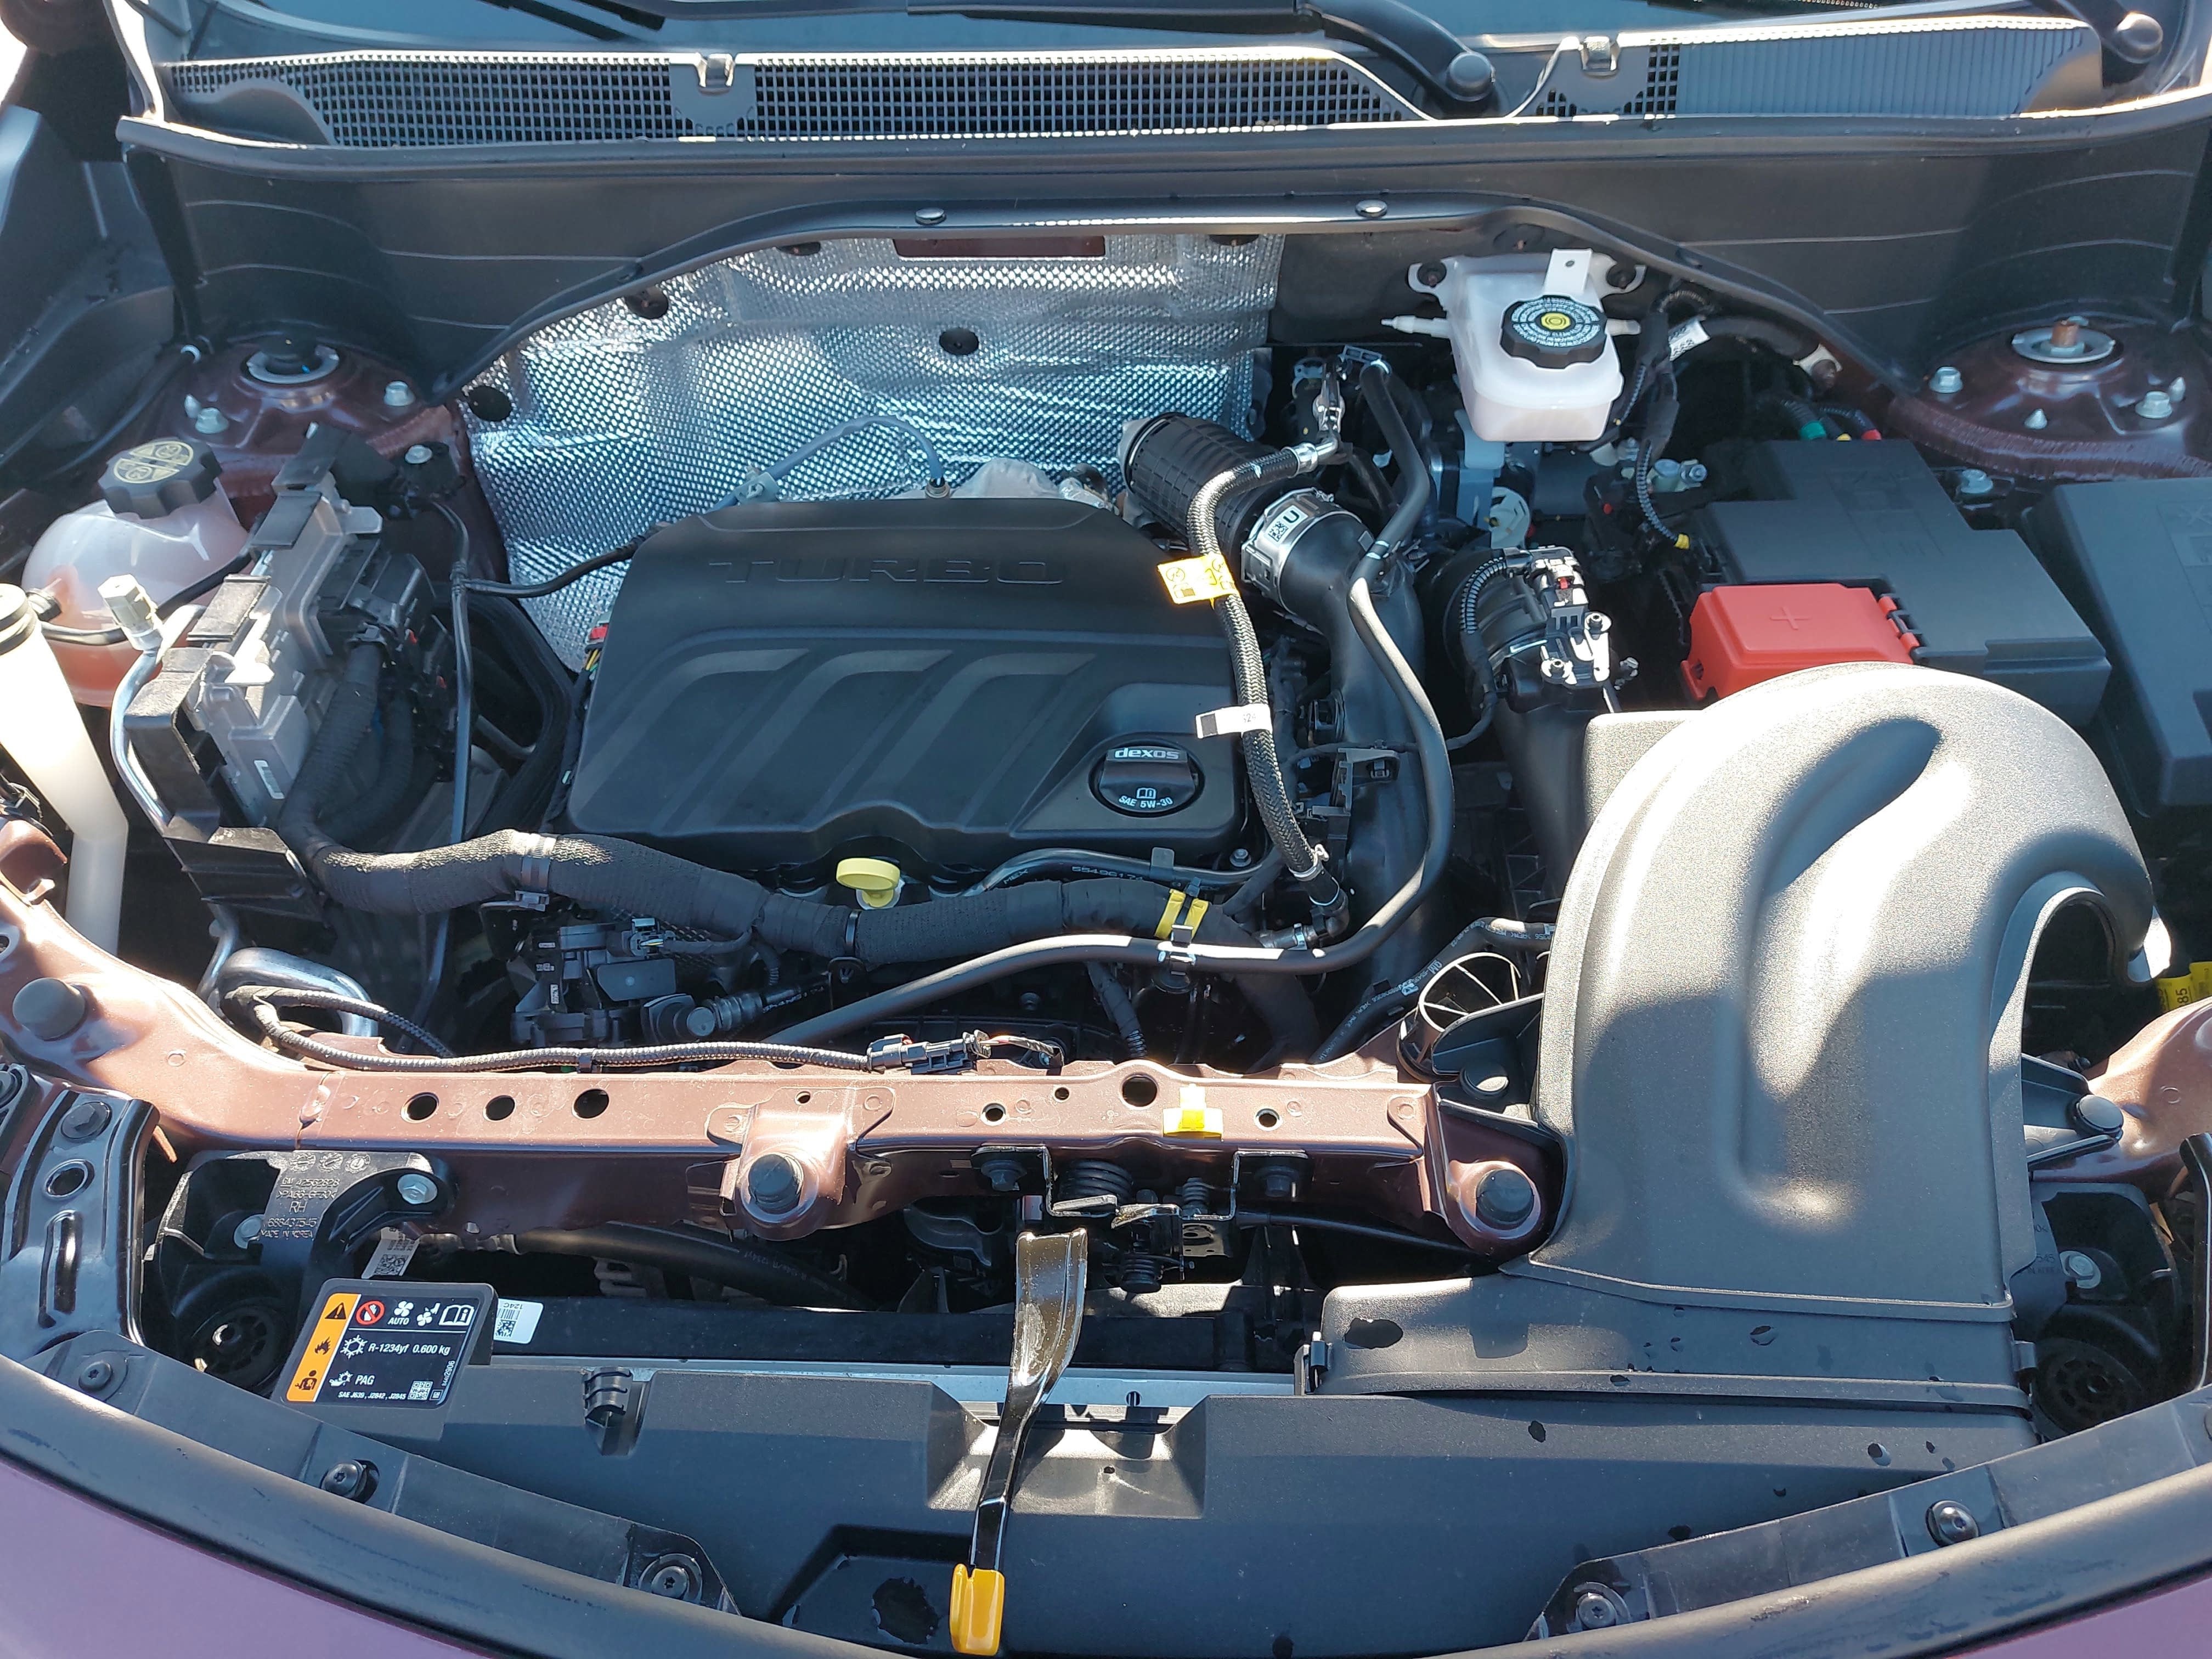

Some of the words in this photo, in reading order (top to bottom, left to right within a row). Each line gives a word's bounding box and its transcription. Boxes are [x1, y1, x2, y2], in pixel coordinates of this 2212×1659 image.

[1283, 510, 1300, 523] U
[708, 560, 1064, 585] TURBO
[1115, 748, 1179, 759] dexos
[1119, 795, 1137, 807] SAE
[1140, 797, 1173, 808] 5W-30
[289, 1200, 308, 1213] RH
[388, 1317, 409, 1325] AUTO
[368, 1342, 410, 1354] R-1234yf
[412, 1343, 437, 1353] 0.600
[436, 1344, 450, 1356] kg
[355, 1375, 375, 1385] PAG
